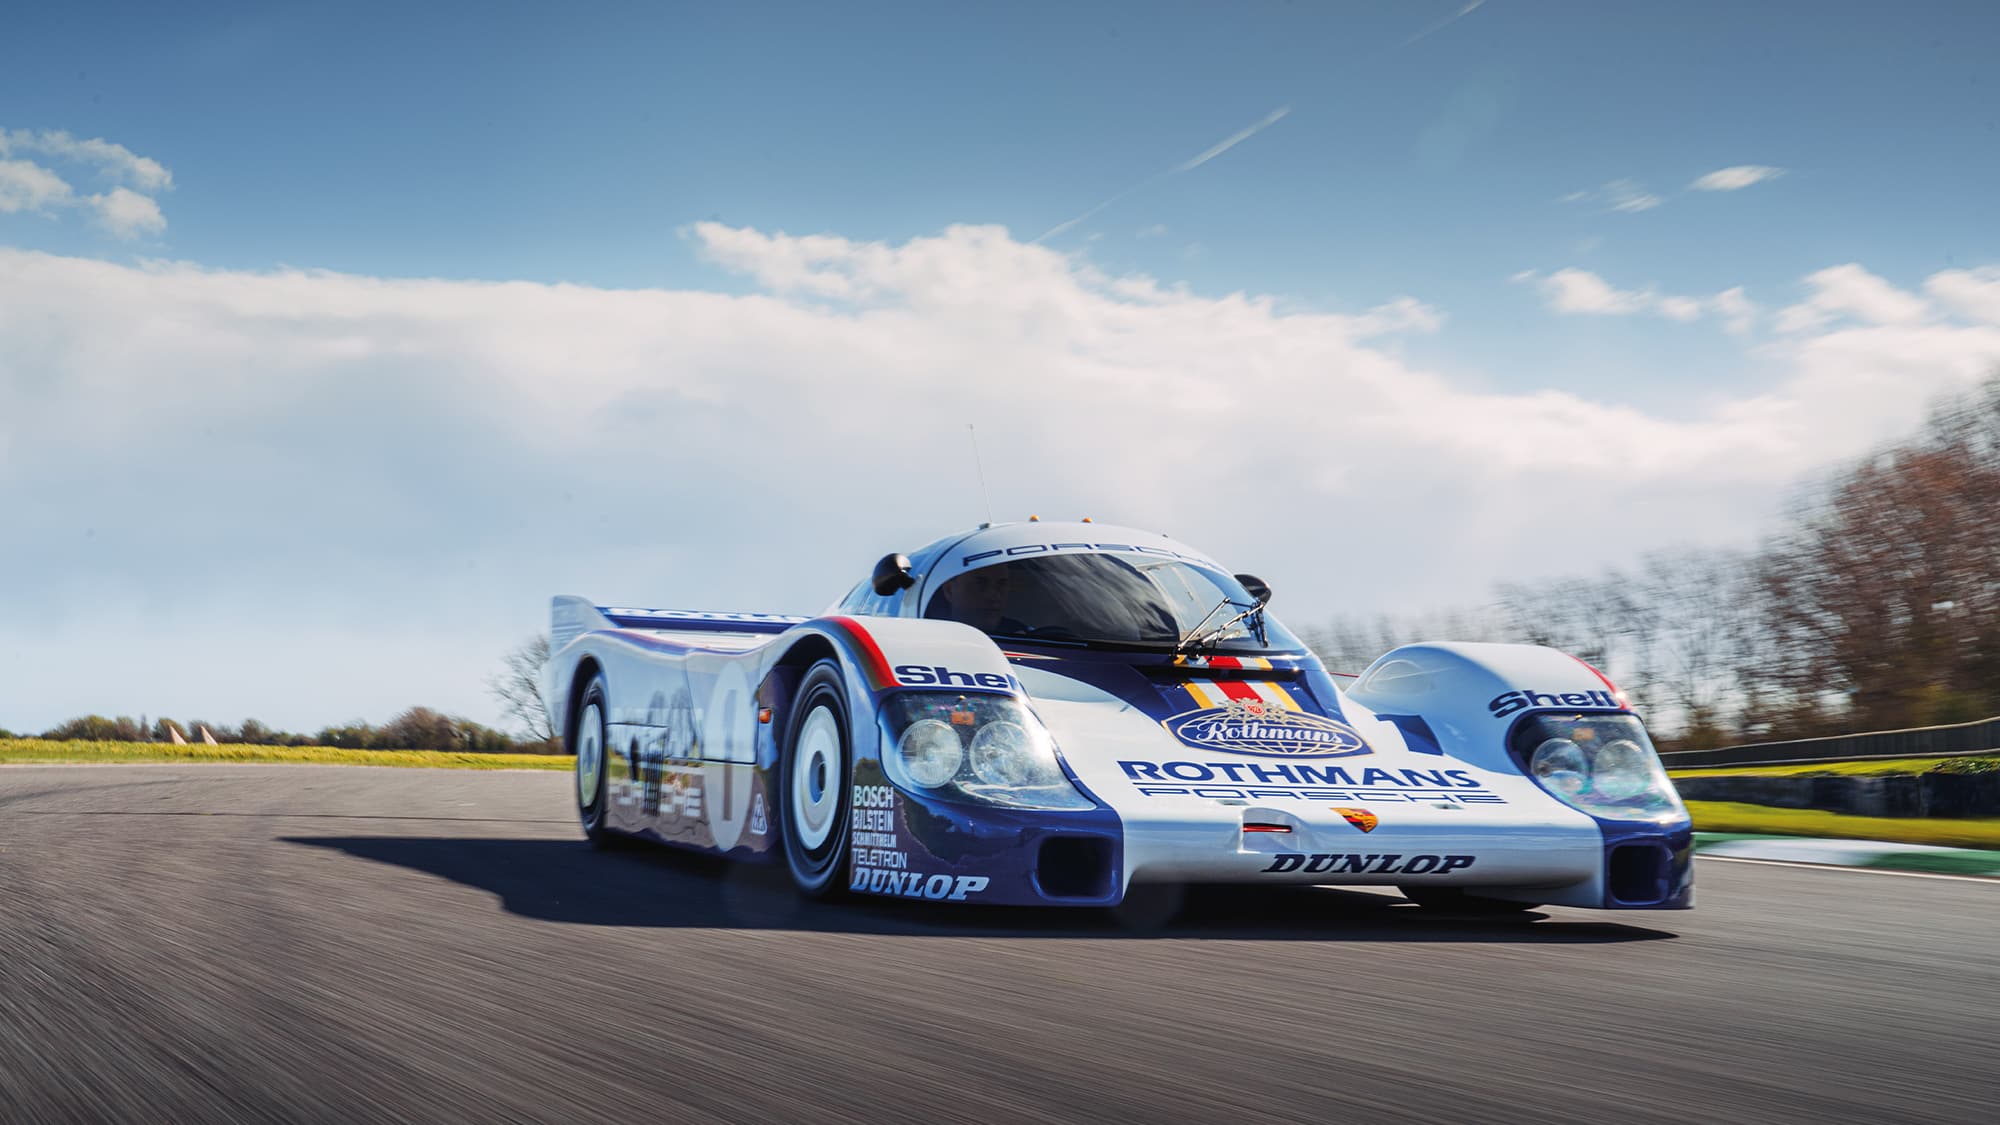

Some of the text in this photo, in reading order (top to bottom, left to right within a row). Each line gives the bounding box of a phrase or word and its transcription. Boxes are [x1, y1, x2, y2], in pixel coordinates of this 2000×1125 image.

[1489, 690, 1618, 719] Shell
[1196, 720, 1344, 745] Rothmans
[1116, 760, 1481, 788] ROTHMANS
[853, 785, 895, 808] BOSCH
[1138, 788, 1509, 804] PORSCHE
[852, 809, 895, 831] BILSTEIN
[851, 847, 908, 869] TELETRON
[1261, 854, 1476, 875] DUNLOP
[849, 866, 990, 900] DUNLOP
